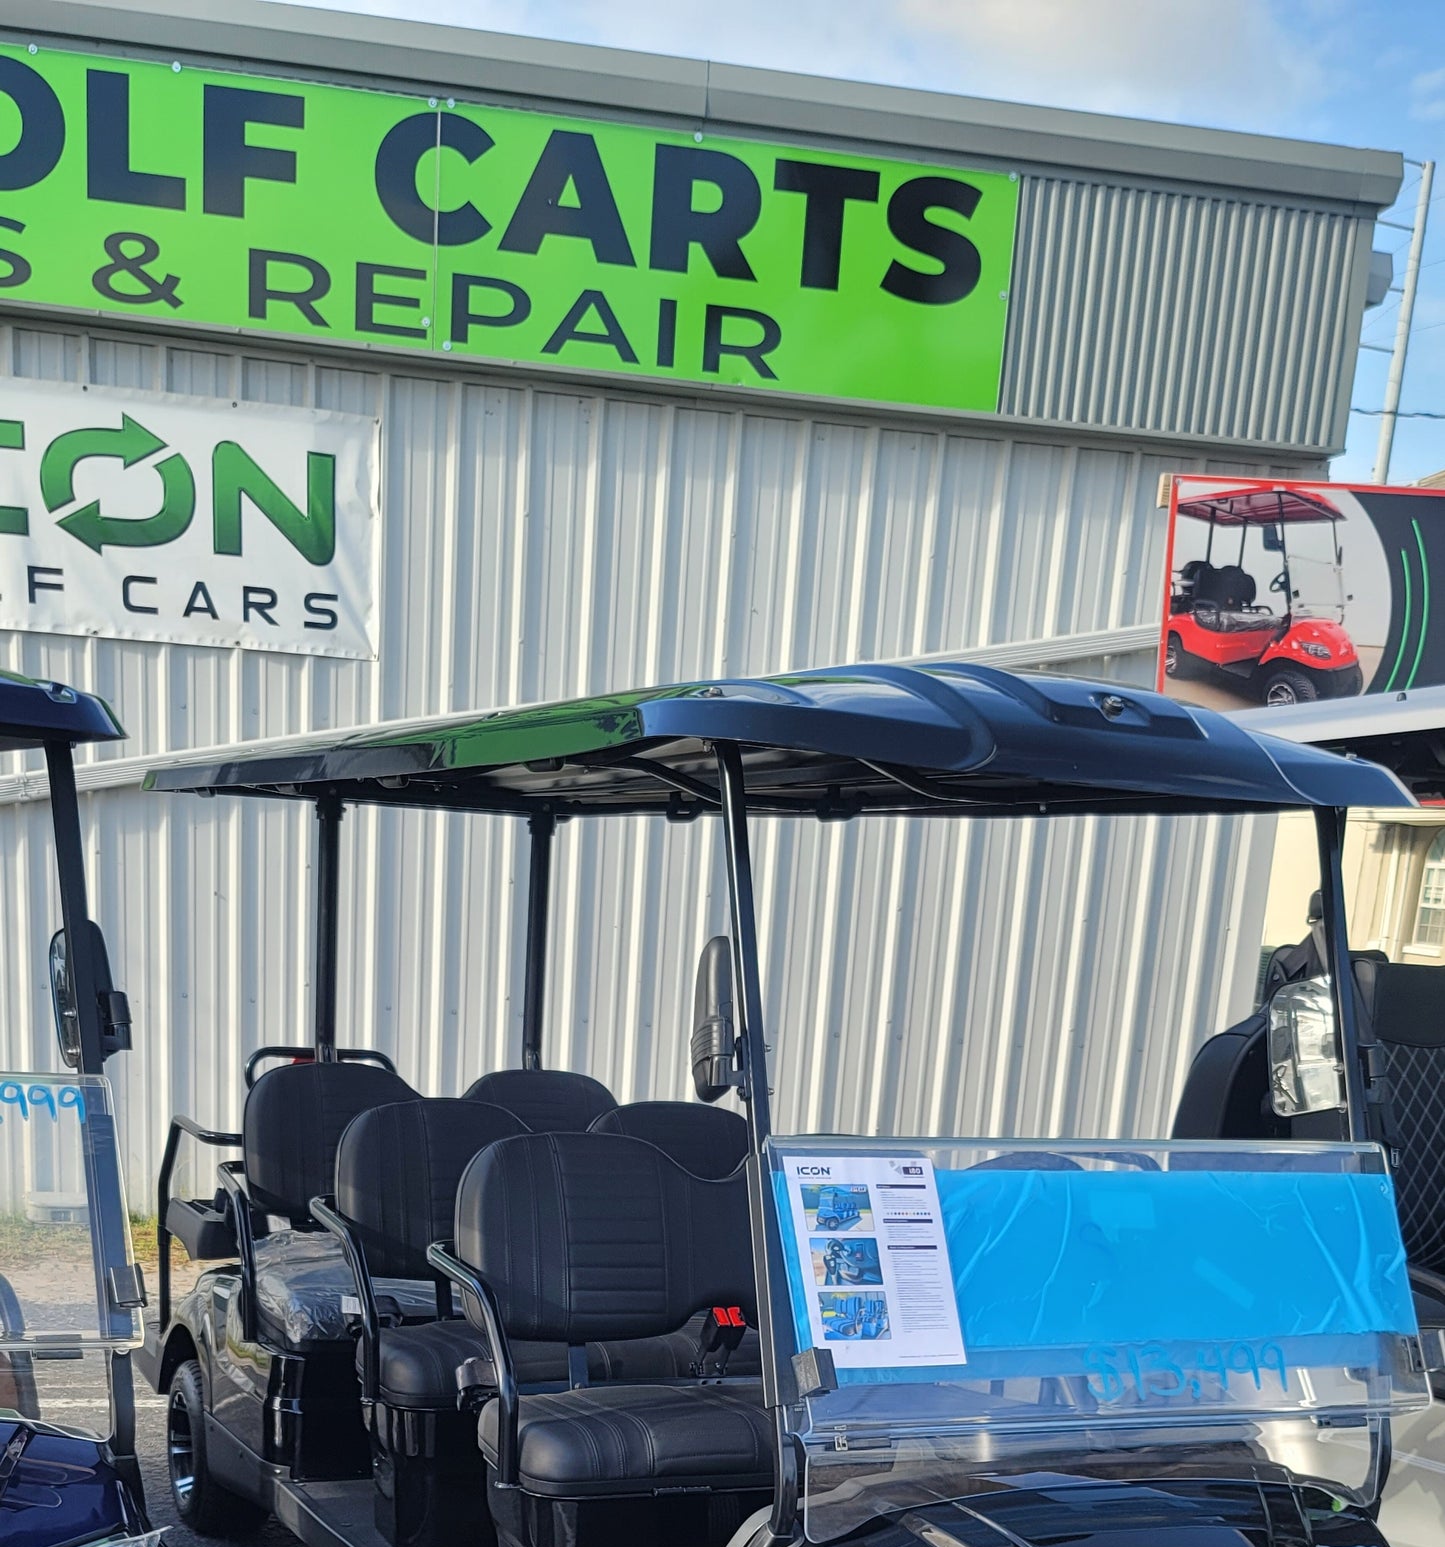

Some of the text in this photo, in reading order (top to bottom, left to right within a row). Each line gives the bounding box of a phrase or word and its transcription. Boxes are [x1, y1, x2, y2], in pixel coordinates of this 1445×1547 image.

[374, 111, 983, 306] CARTS
[91, 231, 184, 310] &
[248, 247, 780, 381] REPAIR
[122, 574, 339, 631] CARS
[796, 1166, 831, 1175] ICON
[1084, 1341, 1289, 1401] $13,499
